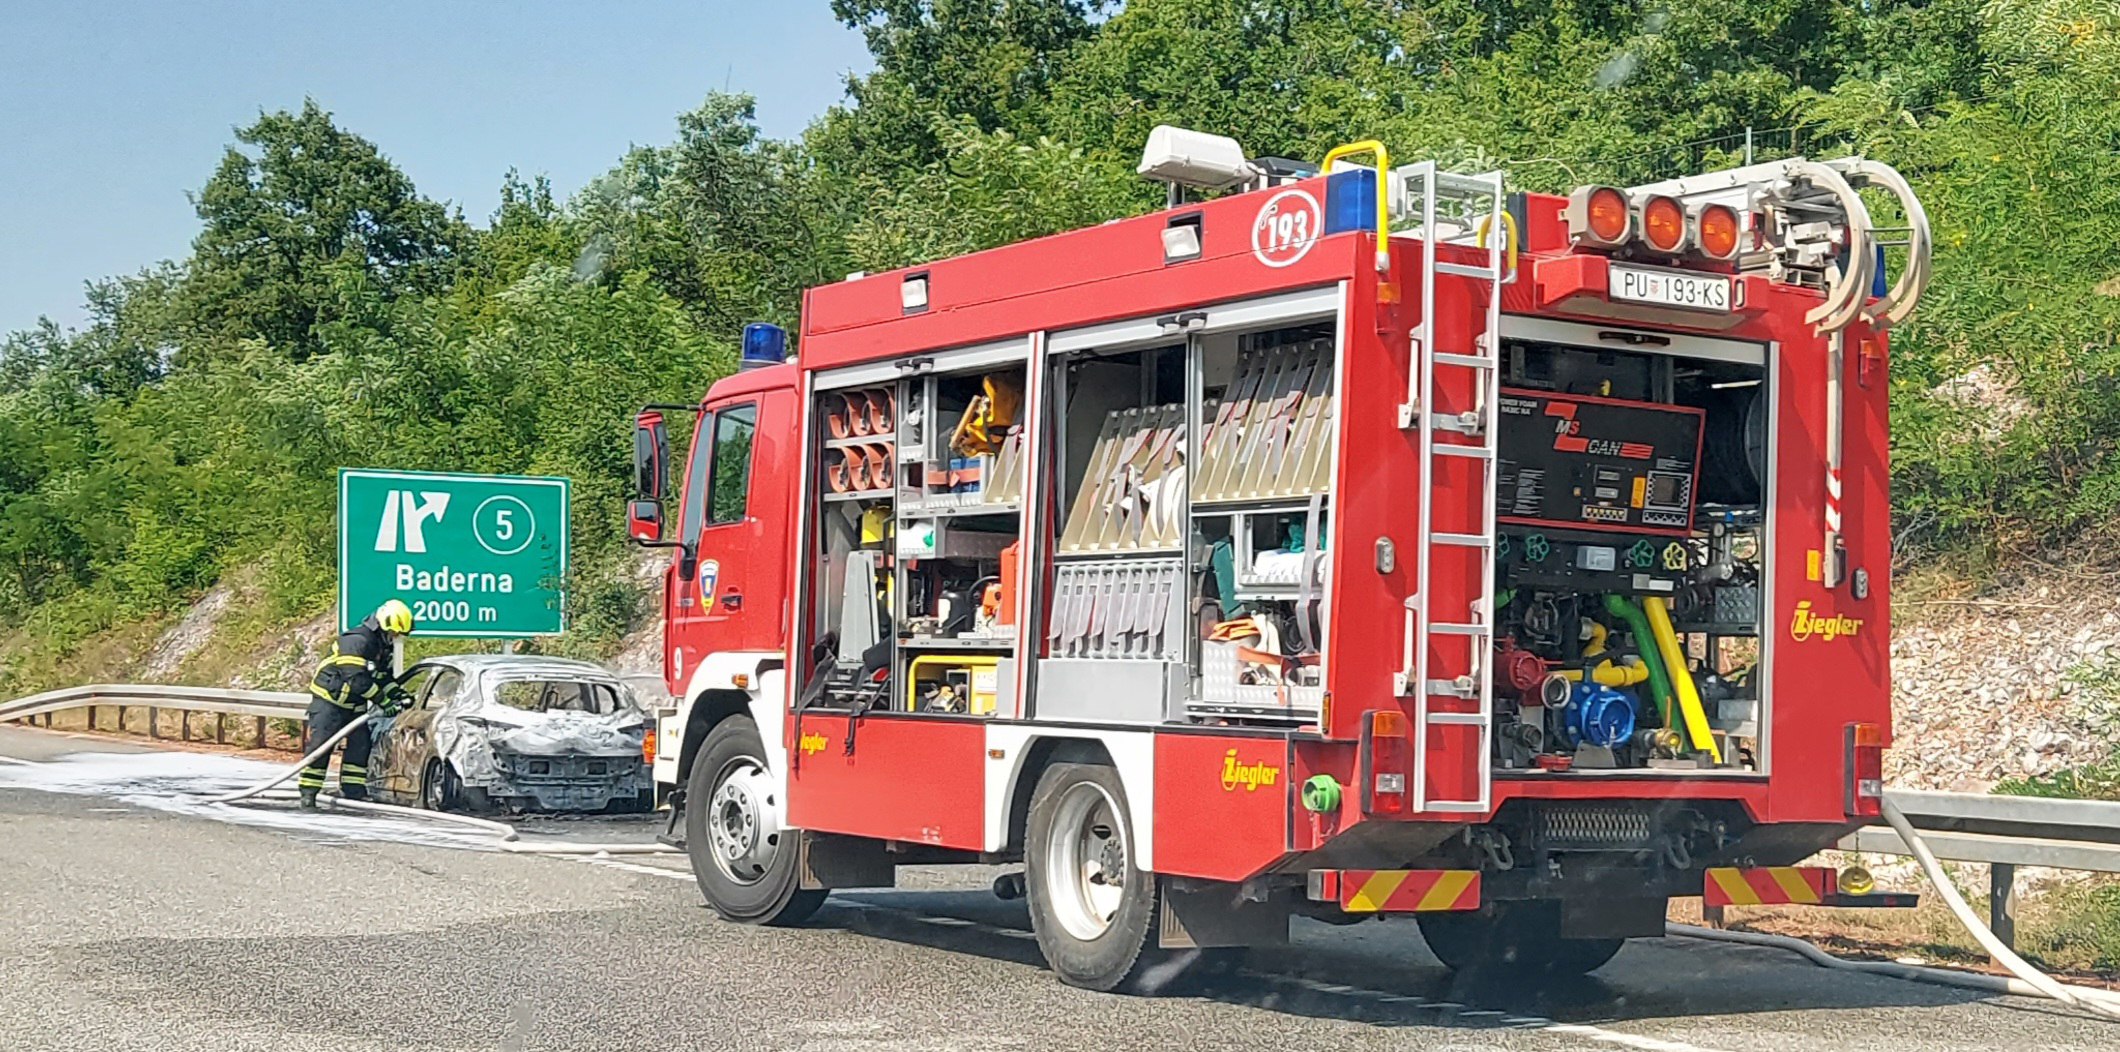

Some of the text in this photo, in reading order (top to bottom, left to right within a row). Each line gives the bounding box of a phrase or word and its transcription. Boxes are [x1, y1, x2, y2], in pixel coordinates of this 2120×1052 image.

[1267, 210, 1308, 253] 193
[1624, 272, 1725, 307] PU 193-KS
[1555, 419, 1580, 435] MS
[495, 510, 514, 541] 5
[396, 563, 513, 593] Baderna
[413, 601, 497, 622] 2000 m
[1791, 600, 1864, 642] Ziegler
[674, 646, 683, 681] 9
[800, 731, 829, 756] iegler
[1221, 748, 1281, 791] Ziegler
